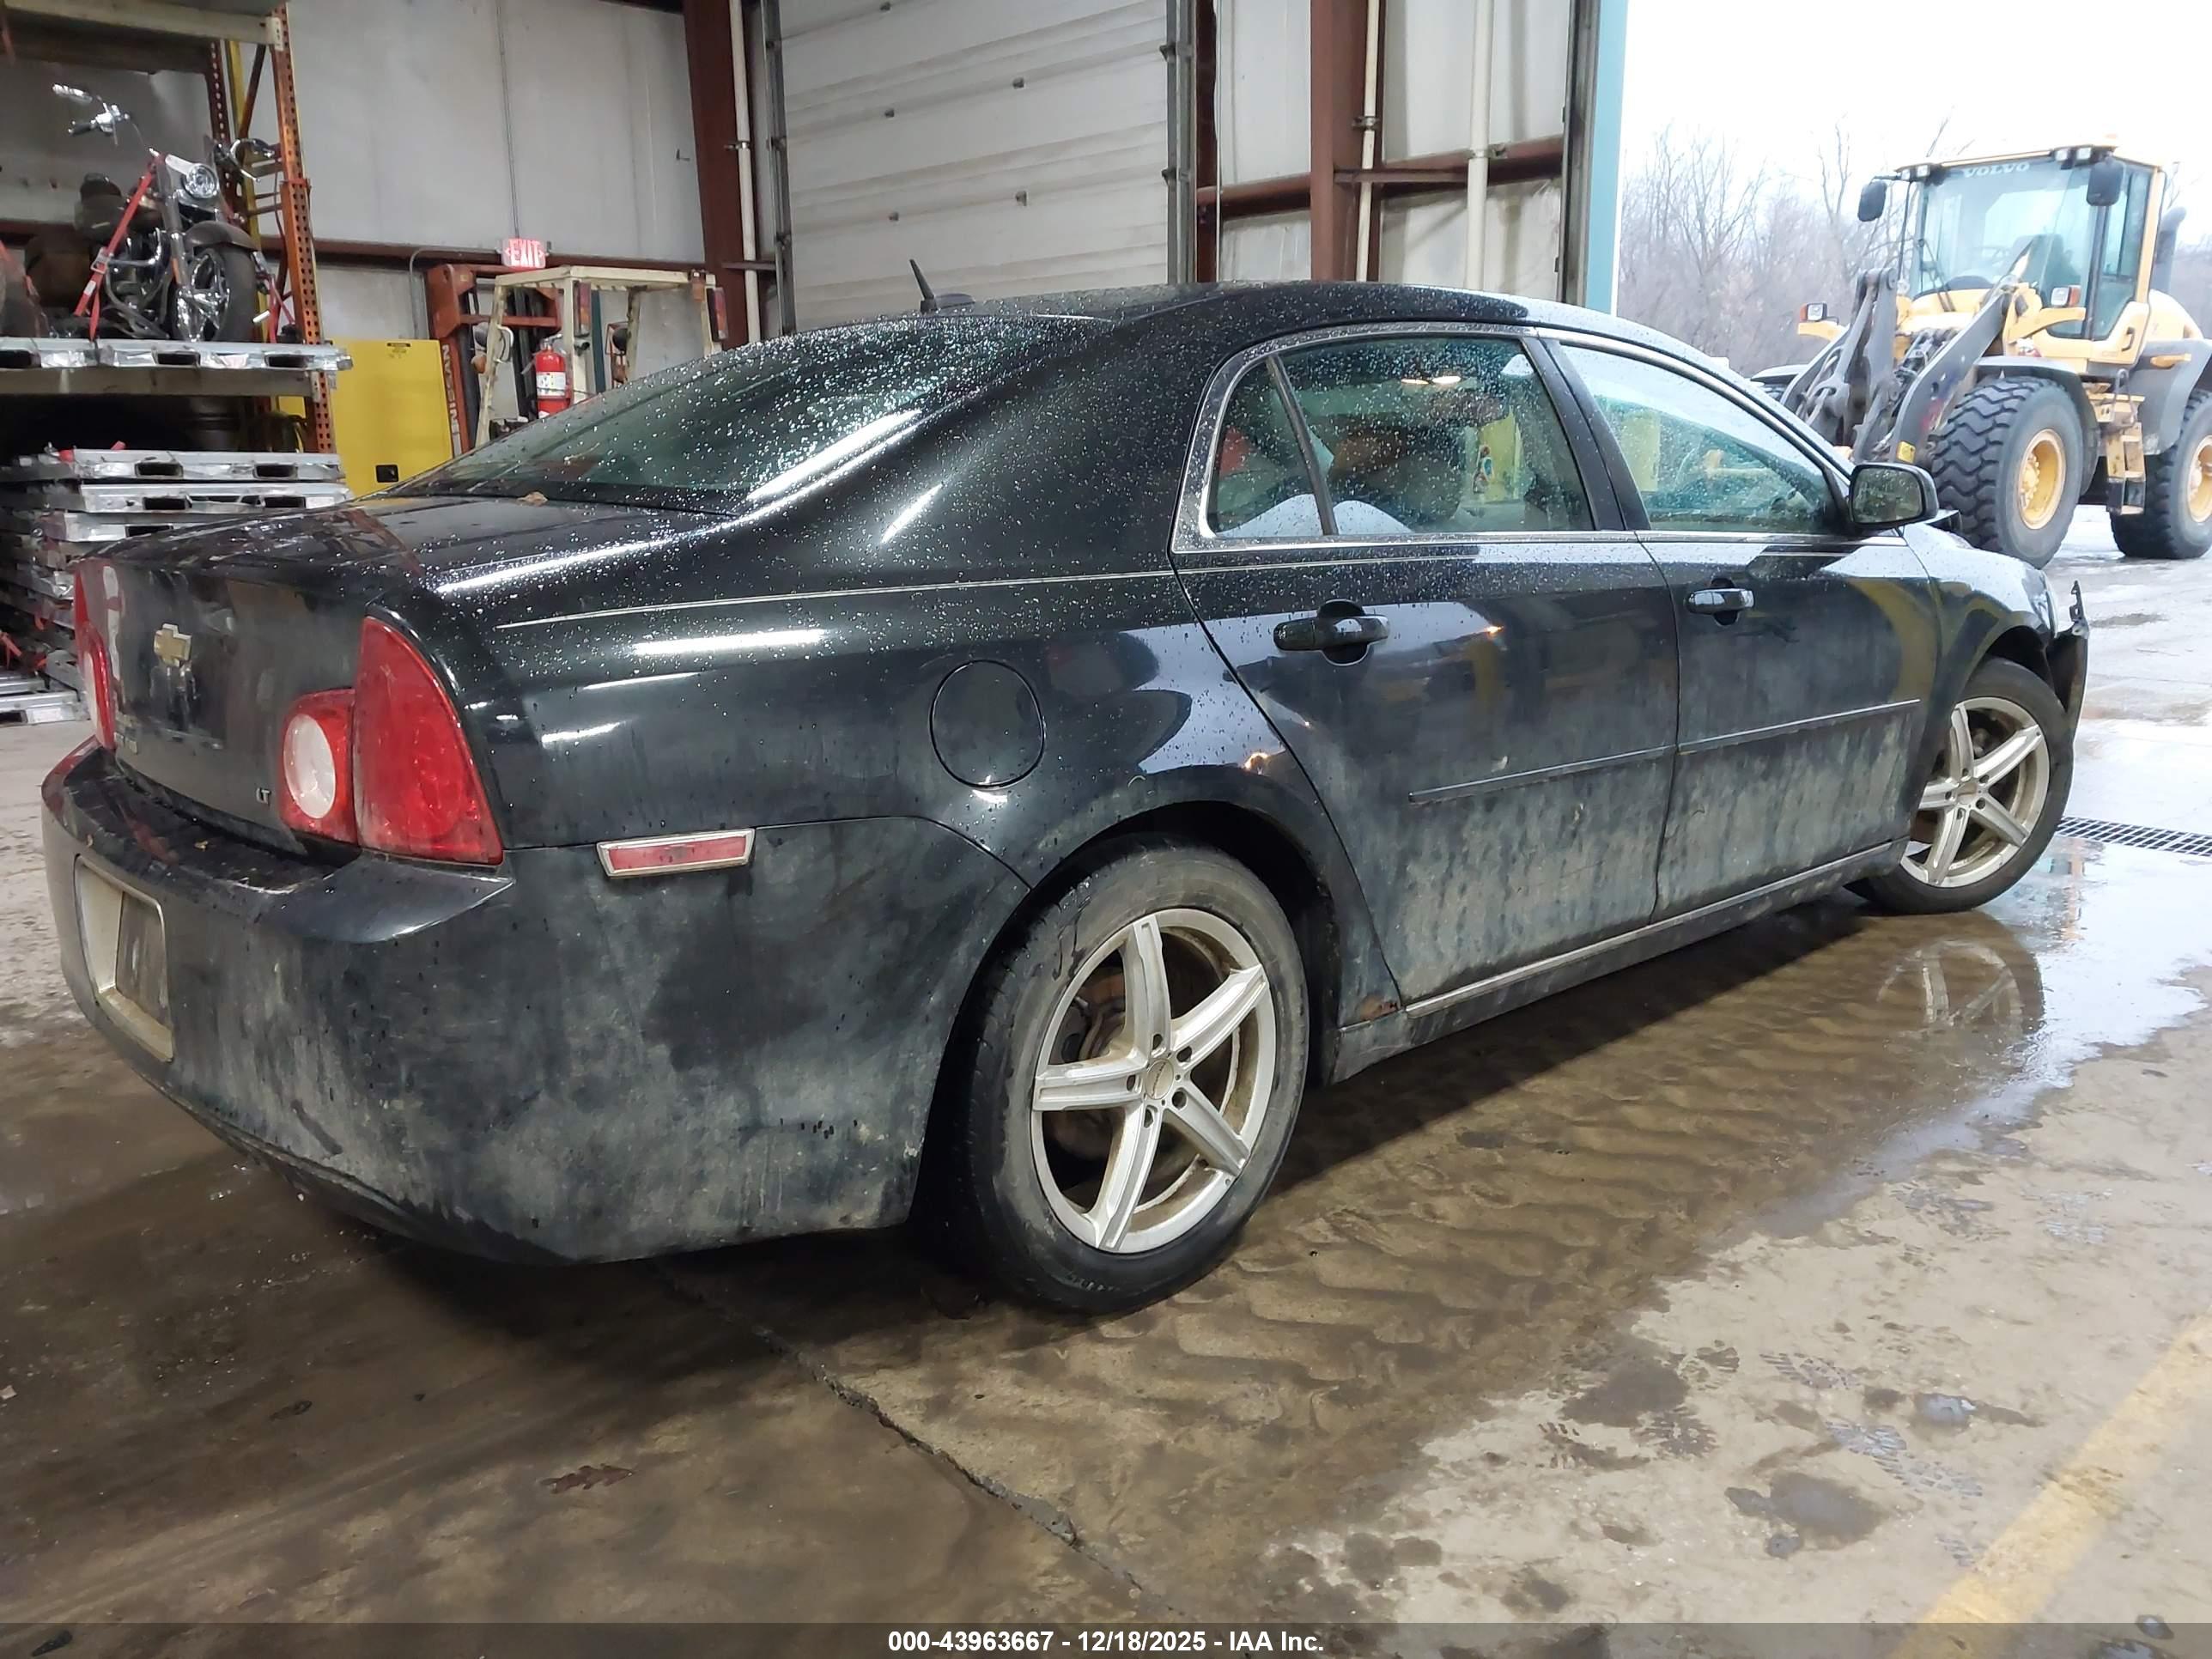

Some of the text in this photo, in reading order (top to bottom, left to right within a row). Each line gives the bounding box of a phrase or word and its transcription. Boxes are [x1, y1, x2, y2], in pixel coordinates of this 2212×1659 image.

[1964, 161, 2030, 178] VOLVO
[509, 240, 540, 268] EXIT
[441, 343, 459, 422] NISSAN
[256, 787, 270, 804] LT
